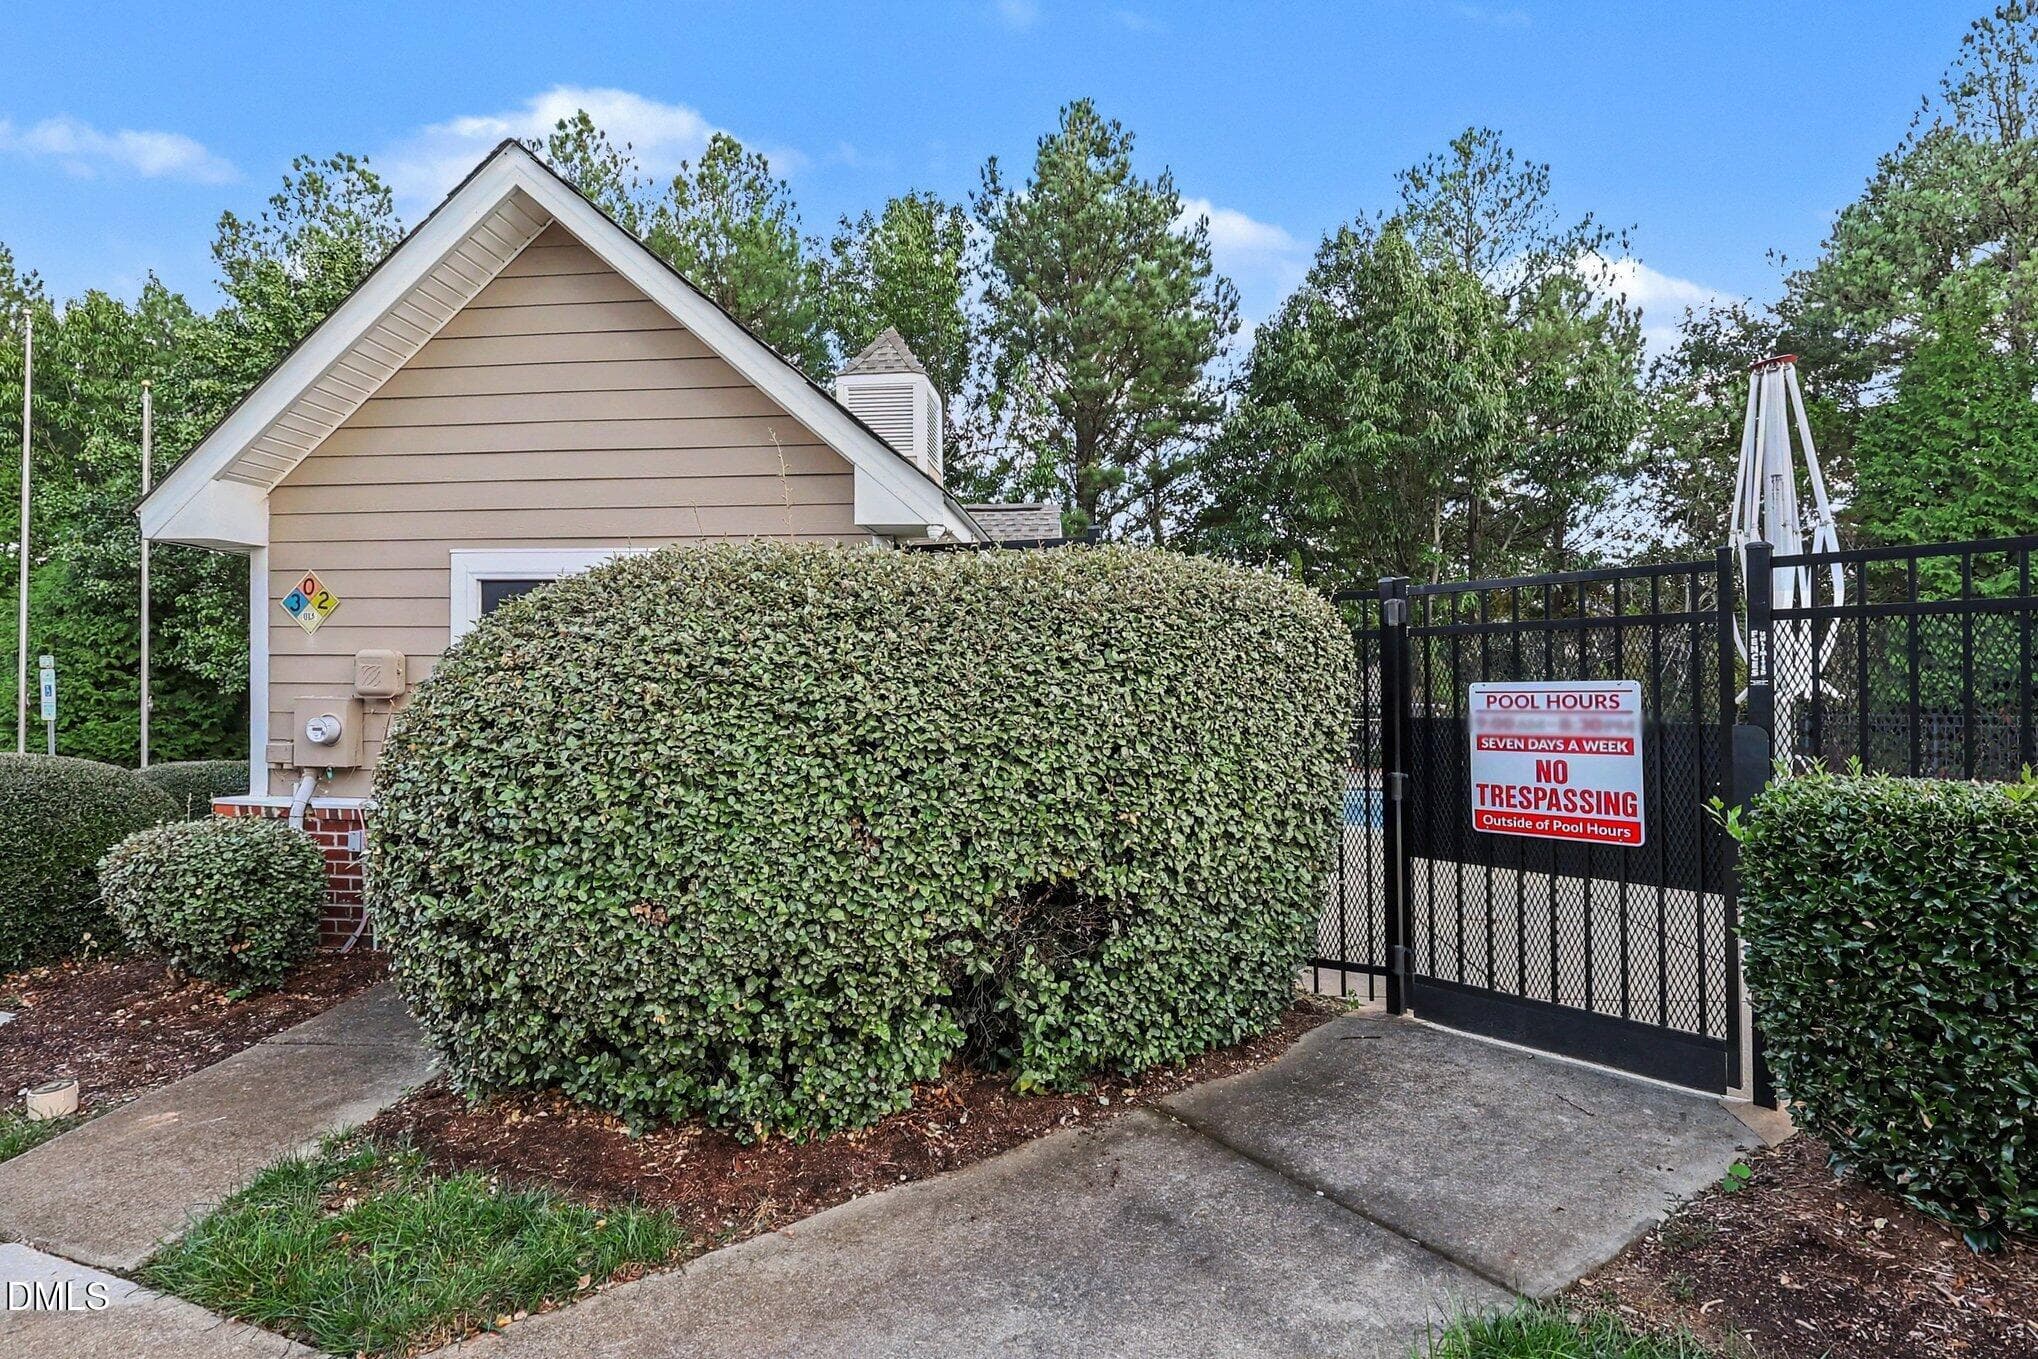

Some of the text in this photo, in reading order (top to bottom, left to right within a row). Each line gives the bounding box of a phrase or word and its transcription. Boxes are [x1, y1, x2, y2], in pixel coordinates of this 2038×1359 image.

[303, 578, 315, 595] 0
[290, 594, 301, 612] 3
[318, 591, 329, 610] 2
[1486, 694, 1620, 709] POOL HOURS
[1481, 737, 1629, 753] SEVEN DAYS A WEEK
[1536, 759, 1568, 784] NO
[1476, 783, 1638, 817] TRESPASSING
[1482, 814, 1631, 837] Outside of Pool Hours
